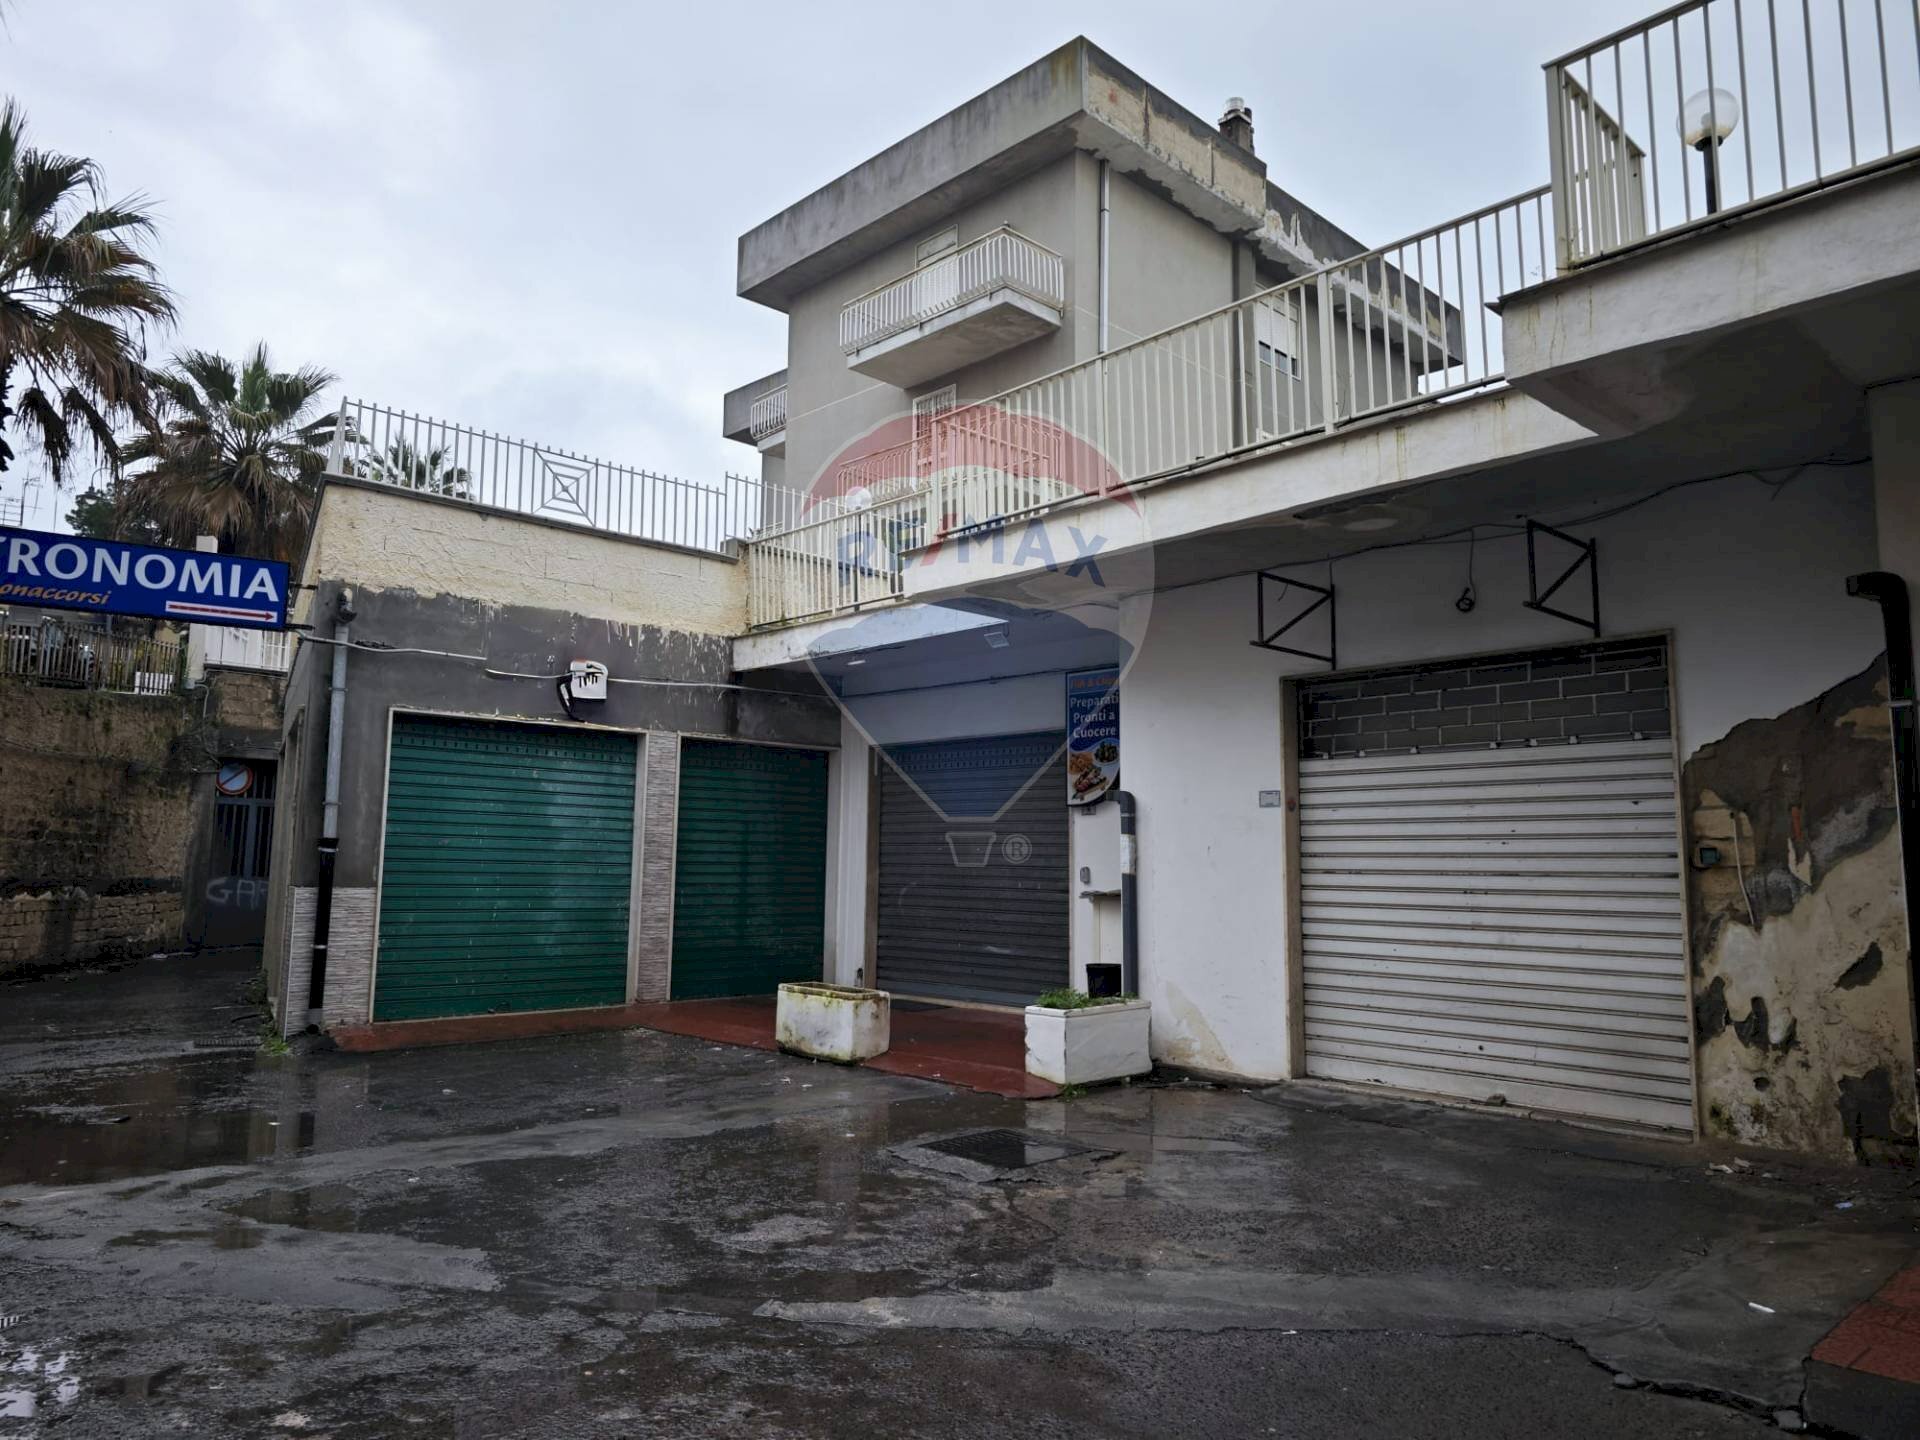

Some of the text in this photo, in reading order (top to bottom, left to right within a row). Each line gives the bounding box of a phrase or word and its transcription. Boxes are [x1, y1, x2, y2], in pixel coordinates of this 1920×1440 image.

[0, 536, 279, 602] RONOMIA
[1070, 692, 1119, 709] Preparati
[1073, 709, 1115, 723] Pronti a
[1073, 727, 1116, 738] Cuocere
